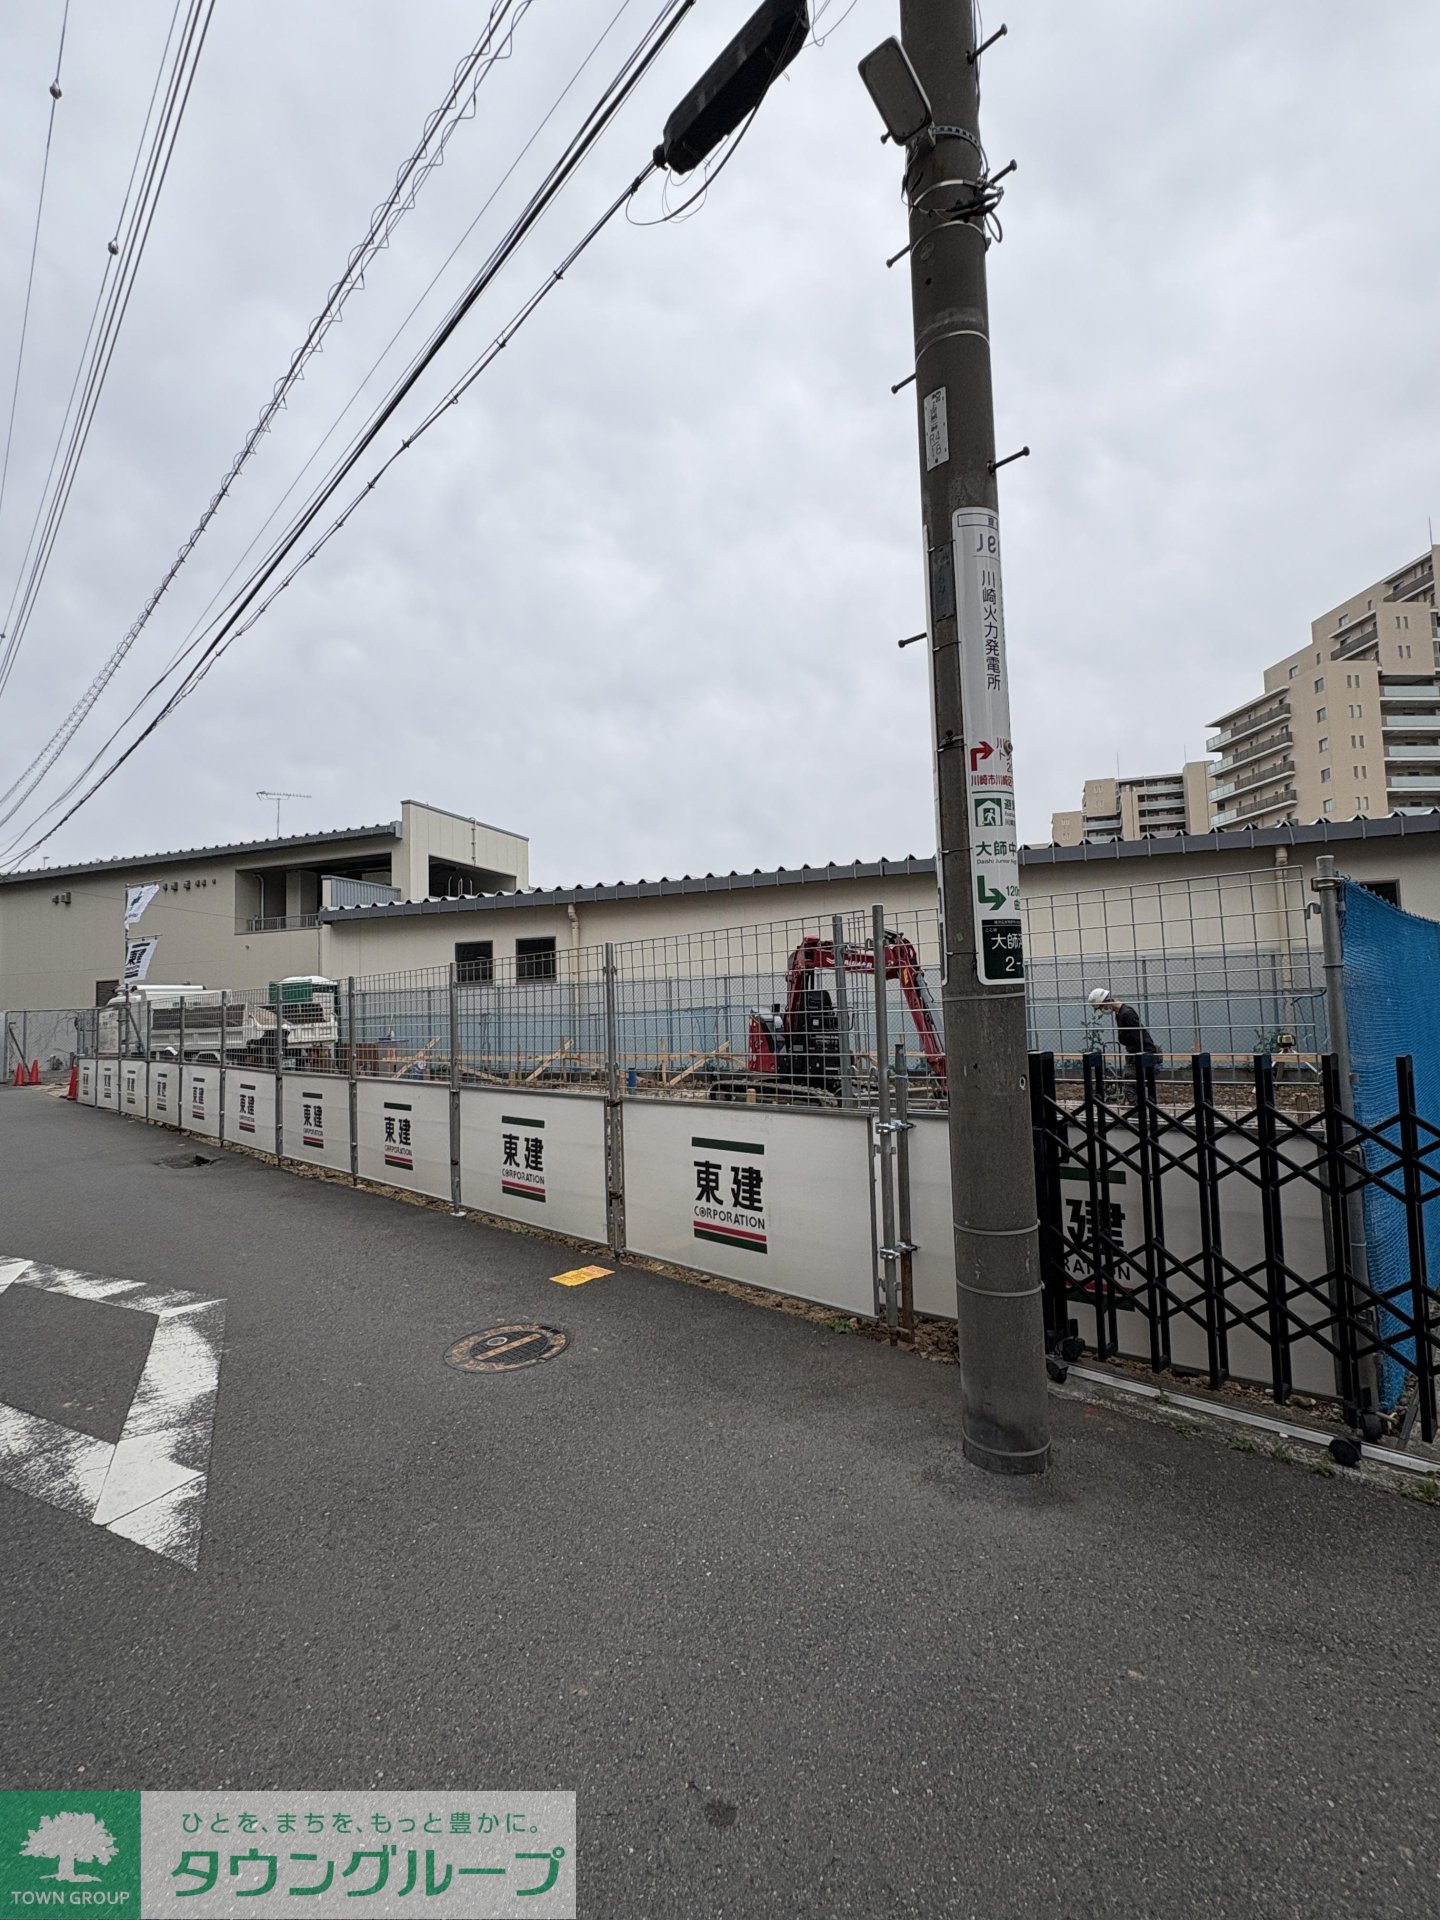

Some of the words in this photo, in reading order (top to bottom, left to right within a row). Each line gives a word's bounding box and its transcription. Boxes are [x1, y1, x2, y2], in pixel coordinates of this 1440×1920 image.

[981, 569, 1001, 692] 川崎火力発電所
[303, 1104, 323, 1129] 東建
[384, 1116, 412, 1147] 東建
[502, 1133, 544, 1172] 東建
[501, 1168, 545, 1185] CORPORATION
[693, 1159, 764, 1212] 東建
[693, 1204, 766, 1231] CORPORATION
